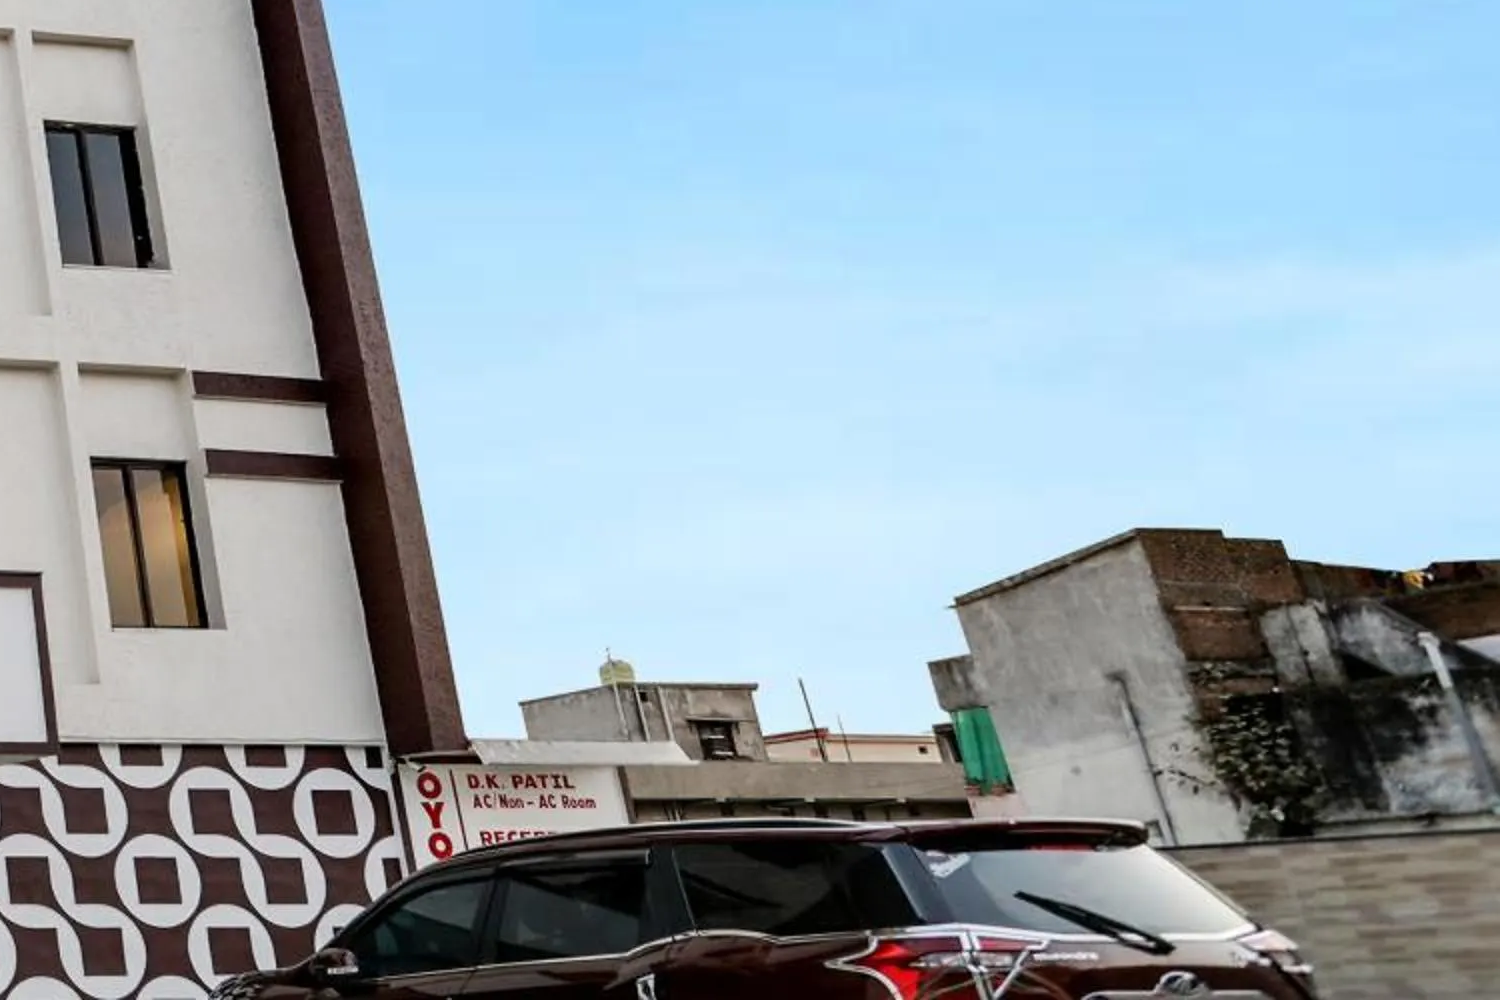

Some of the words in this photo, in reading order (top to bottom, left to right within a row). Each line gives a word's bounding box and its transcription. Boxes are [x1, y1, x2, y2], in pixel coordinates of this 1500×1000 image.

[511, 774, 575, 789] PATIL
[539, 795, 557, 808] AC
[561, 795, 597, 808] Room
[417, 772, 453, 859] OYO
